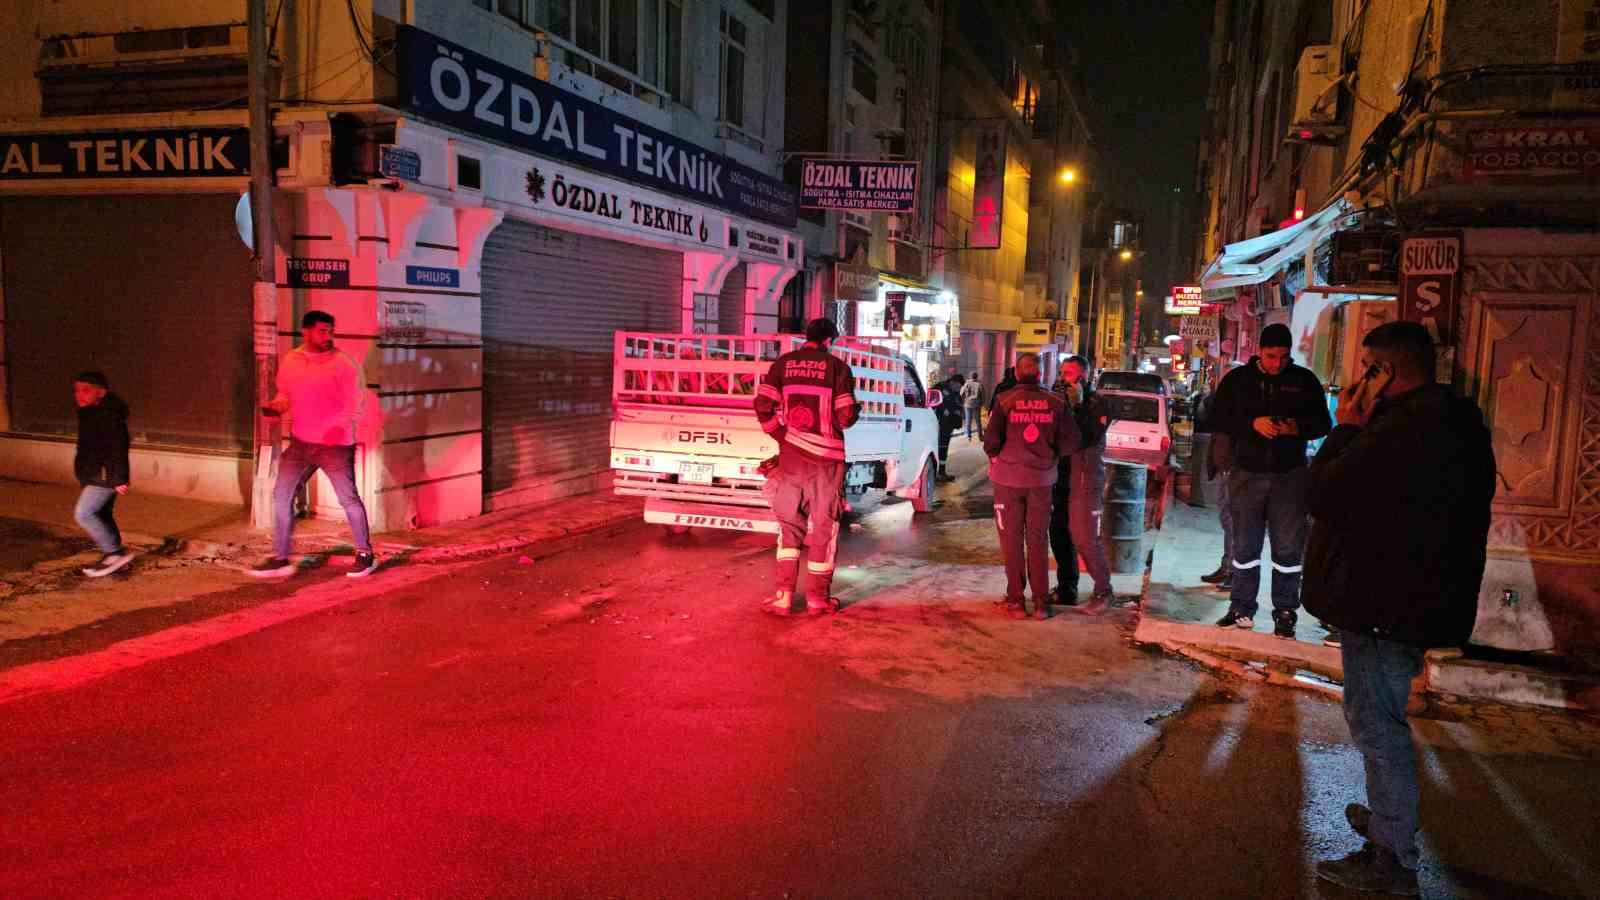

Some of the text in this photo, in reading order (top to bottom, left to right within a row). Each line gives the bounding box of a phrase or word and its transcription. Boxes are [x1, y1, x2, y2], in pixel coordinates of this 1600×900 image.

[429, 44, 724, 201] ÖZDAL TEKNİK
[68, 131, 235, 173] TEKNİK
[1468, 151, 1600, 167] TOBACCO
[804, 161, 915, 190] ÖZDAL TEKNİK
[551, 173, 694, 237] ÖZDAL TEKNİK
[287, 260, 347, 272] TECUMSEH
[302, 272, 332, 283] GRUP
[416, 270, 452, 284] PHILIPS
[678, 430, 732, 445] DFSK
